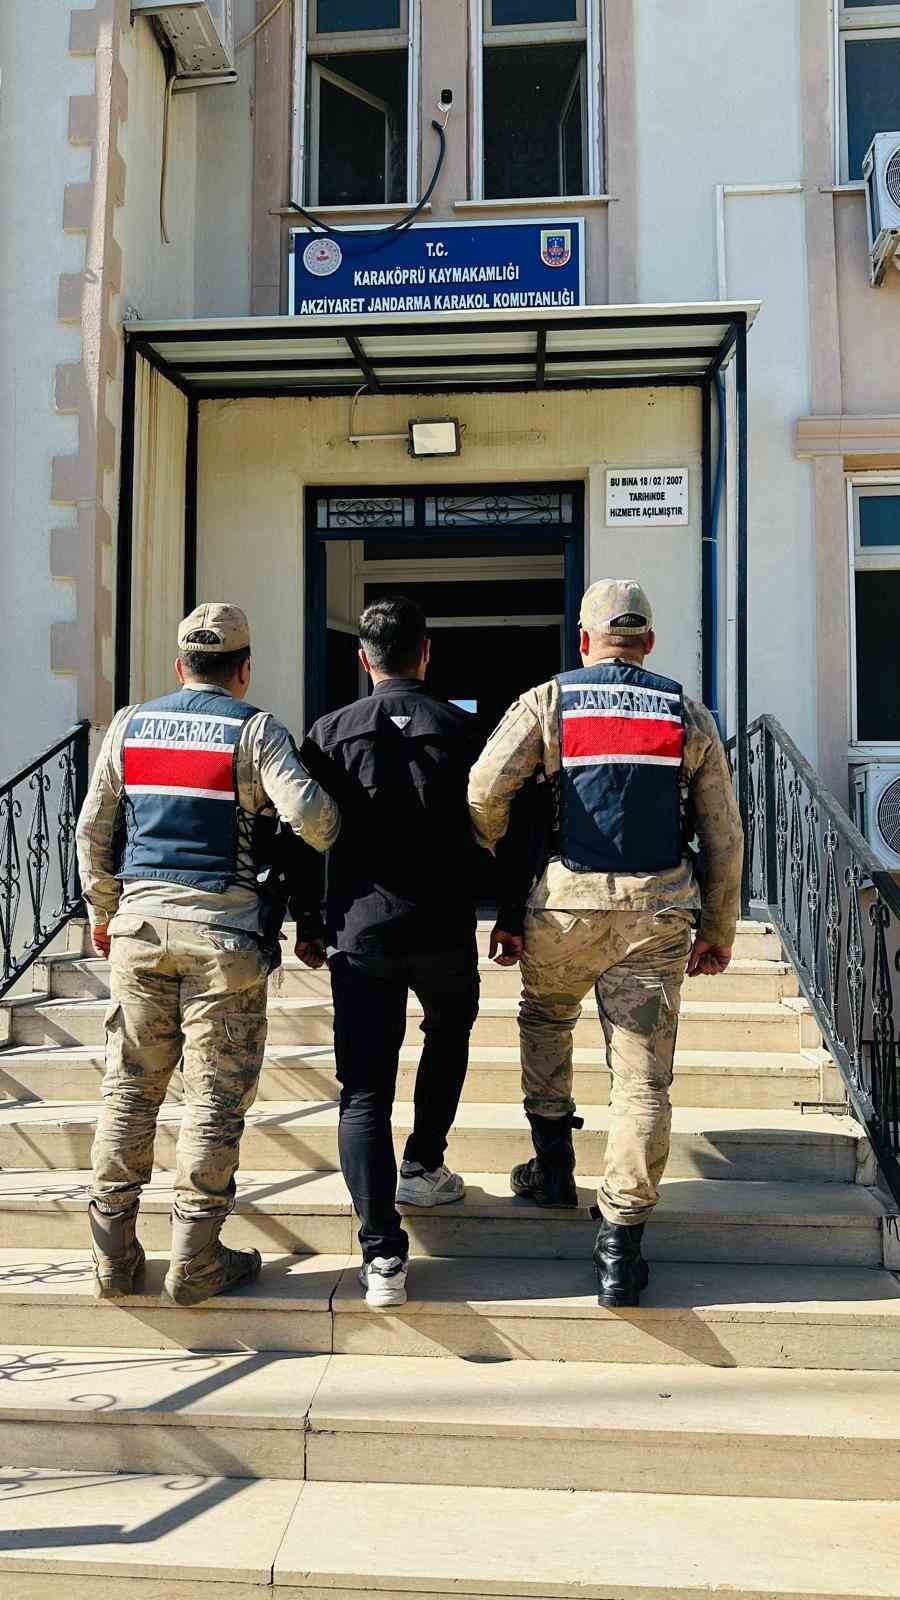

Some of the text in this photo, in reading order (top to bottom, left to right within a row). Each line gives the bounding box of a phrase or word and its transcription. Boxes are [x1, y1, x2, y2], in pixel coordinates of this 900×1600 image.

[426, 242, 449, 257] T.C.
[354, 262, 520, 286] KARAKÖPRÜ KAYMAKAMLIĞI
[300, 288, 574, 315] AKZİYARET JANDARMA KARAKOL KOMUTANLIĞI
[610, 478, 620, 486] BU
[667, 476, 683, 485] 2007
[573, 689, 672, 715] JANDARMA
[135, 718, 225, 744] JANDARMA
